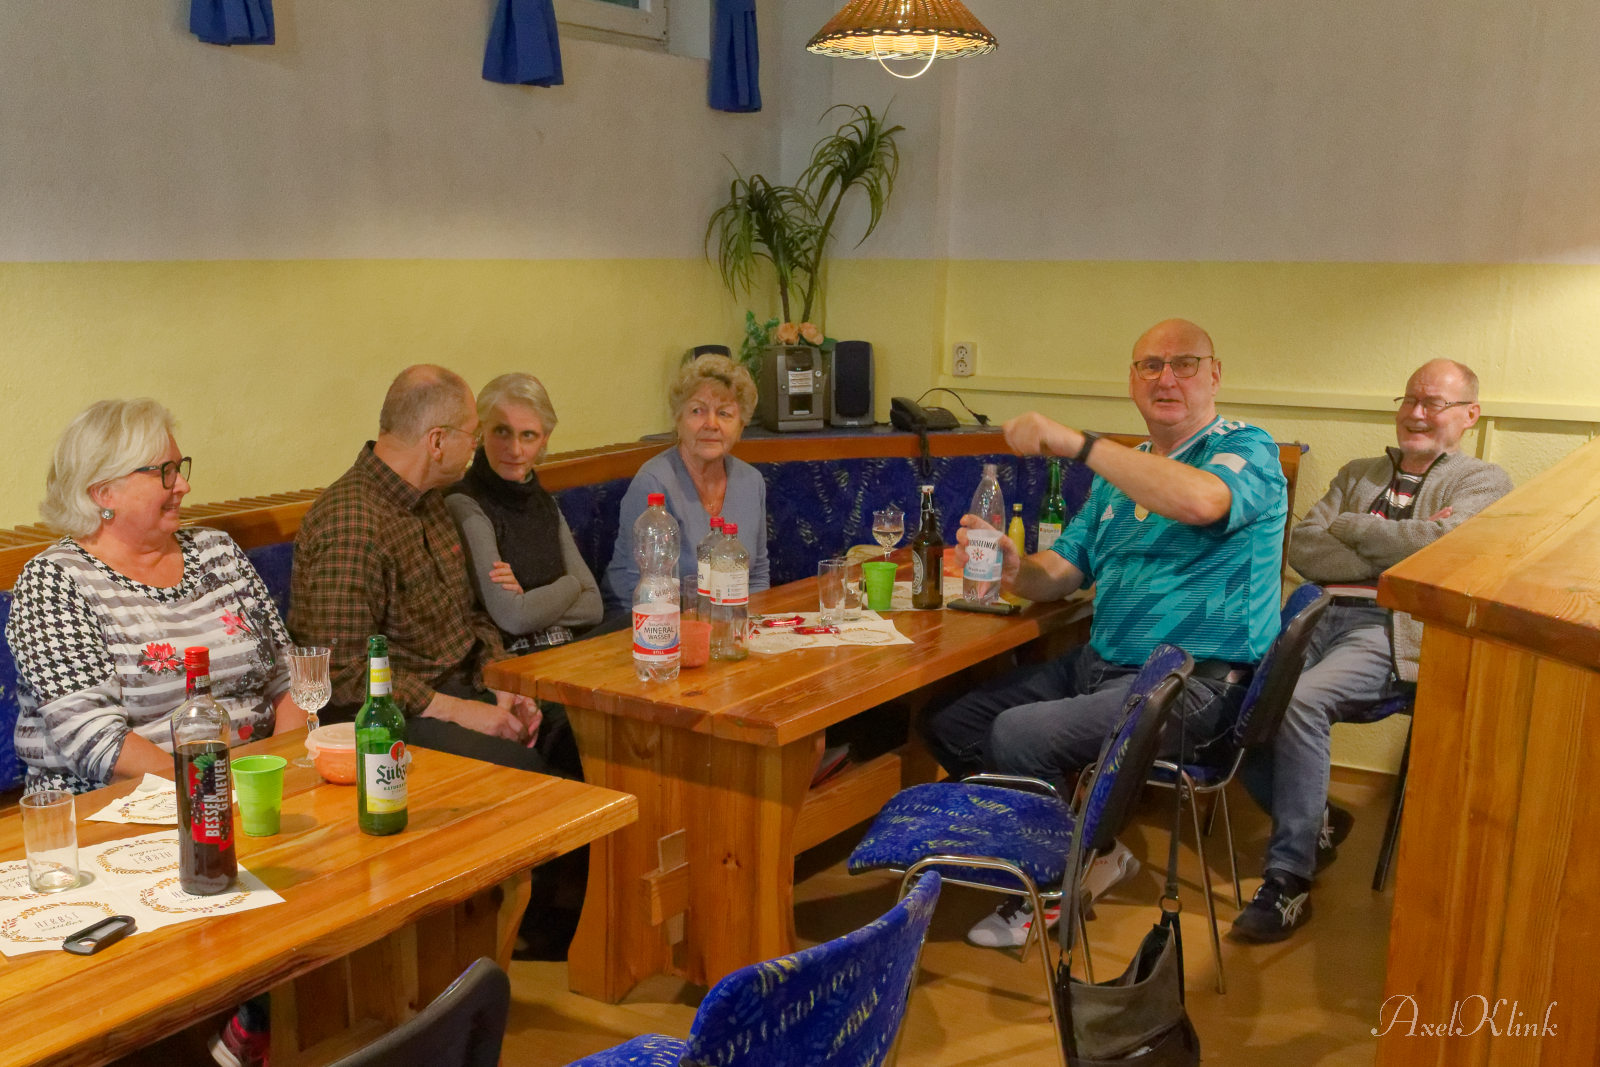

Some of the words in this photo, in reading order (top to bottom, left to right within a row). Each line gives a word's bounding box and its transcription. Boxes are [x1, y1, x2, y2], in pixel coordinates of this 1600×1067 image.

[644, 626, 675, 635] MINERAL
[214, 759, 229, 811] GENEVER
[203, 794, 220, 837] BESSEN
[34, 912, 80, 929] HERBST
